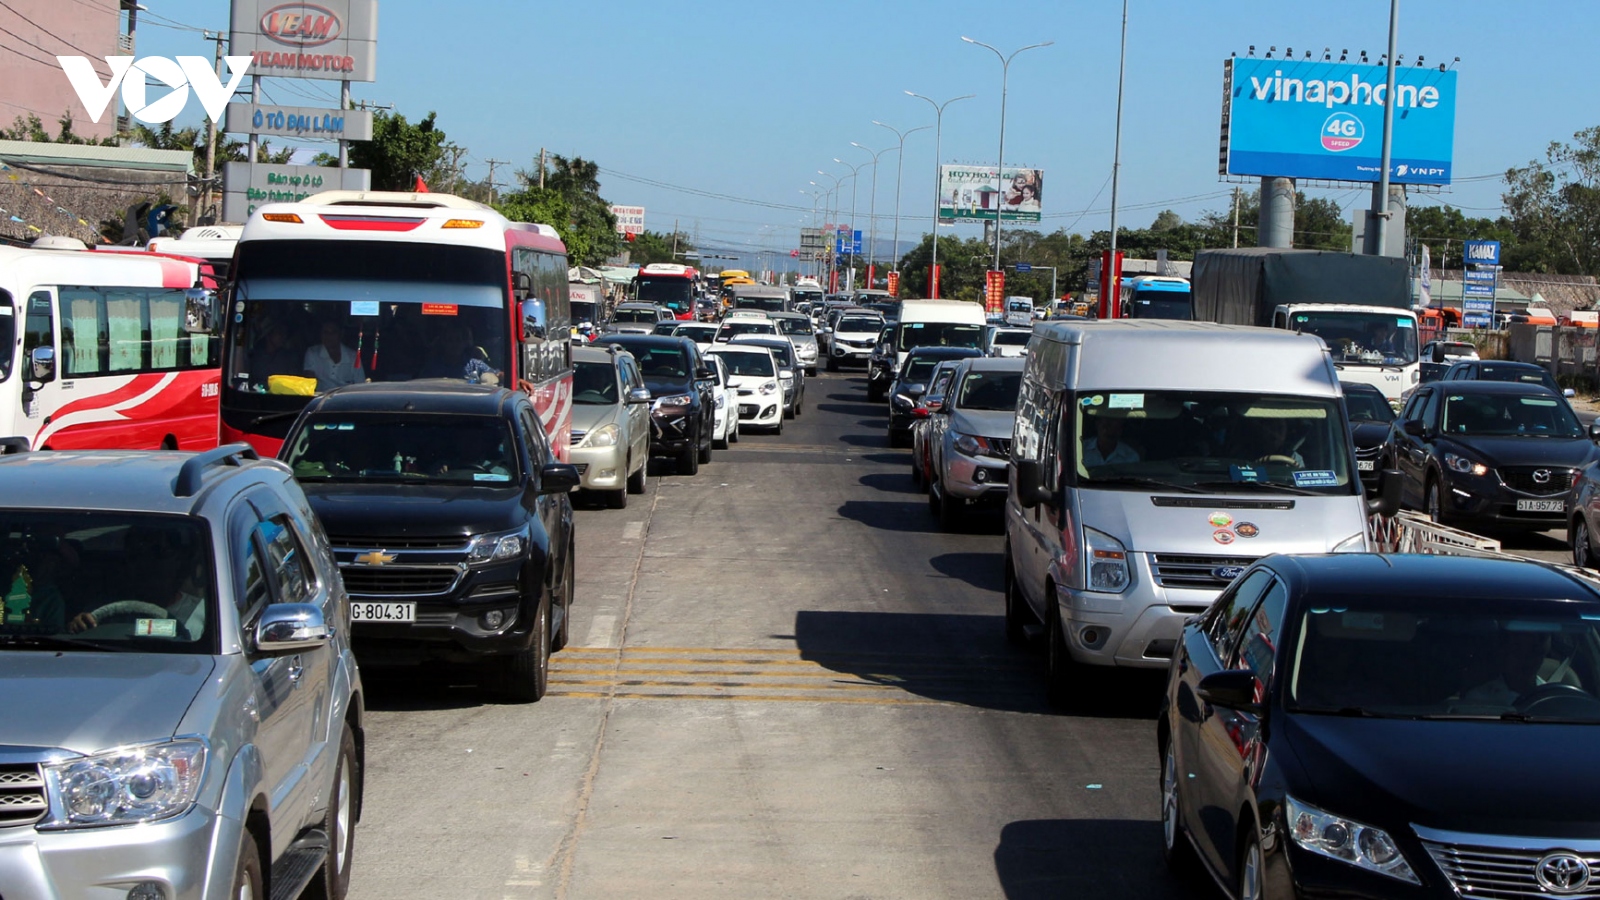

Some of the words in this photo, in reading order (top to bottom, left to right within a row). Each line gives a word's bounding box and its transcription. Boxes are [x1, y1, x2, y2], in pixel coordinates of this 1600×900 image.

[268, 12, 335, 38] VEAM
[251, 51, 296, 69] VEAM
[298, 54, 354, 72] MOTOR
[1250, 70, 1440, 109] vinaphone
[253, 109, 264, 128] Ô
[267, 110, 285, 130] TÔ
[314, 114, 344, 133] LÂM
[1327, 119, 1356, 136] 4G
[1410, 168, 1445, 176] VNPT
[1468, 244, 1496, 260] KAMAZ
[352, 604, 411, 620] G-804.31
